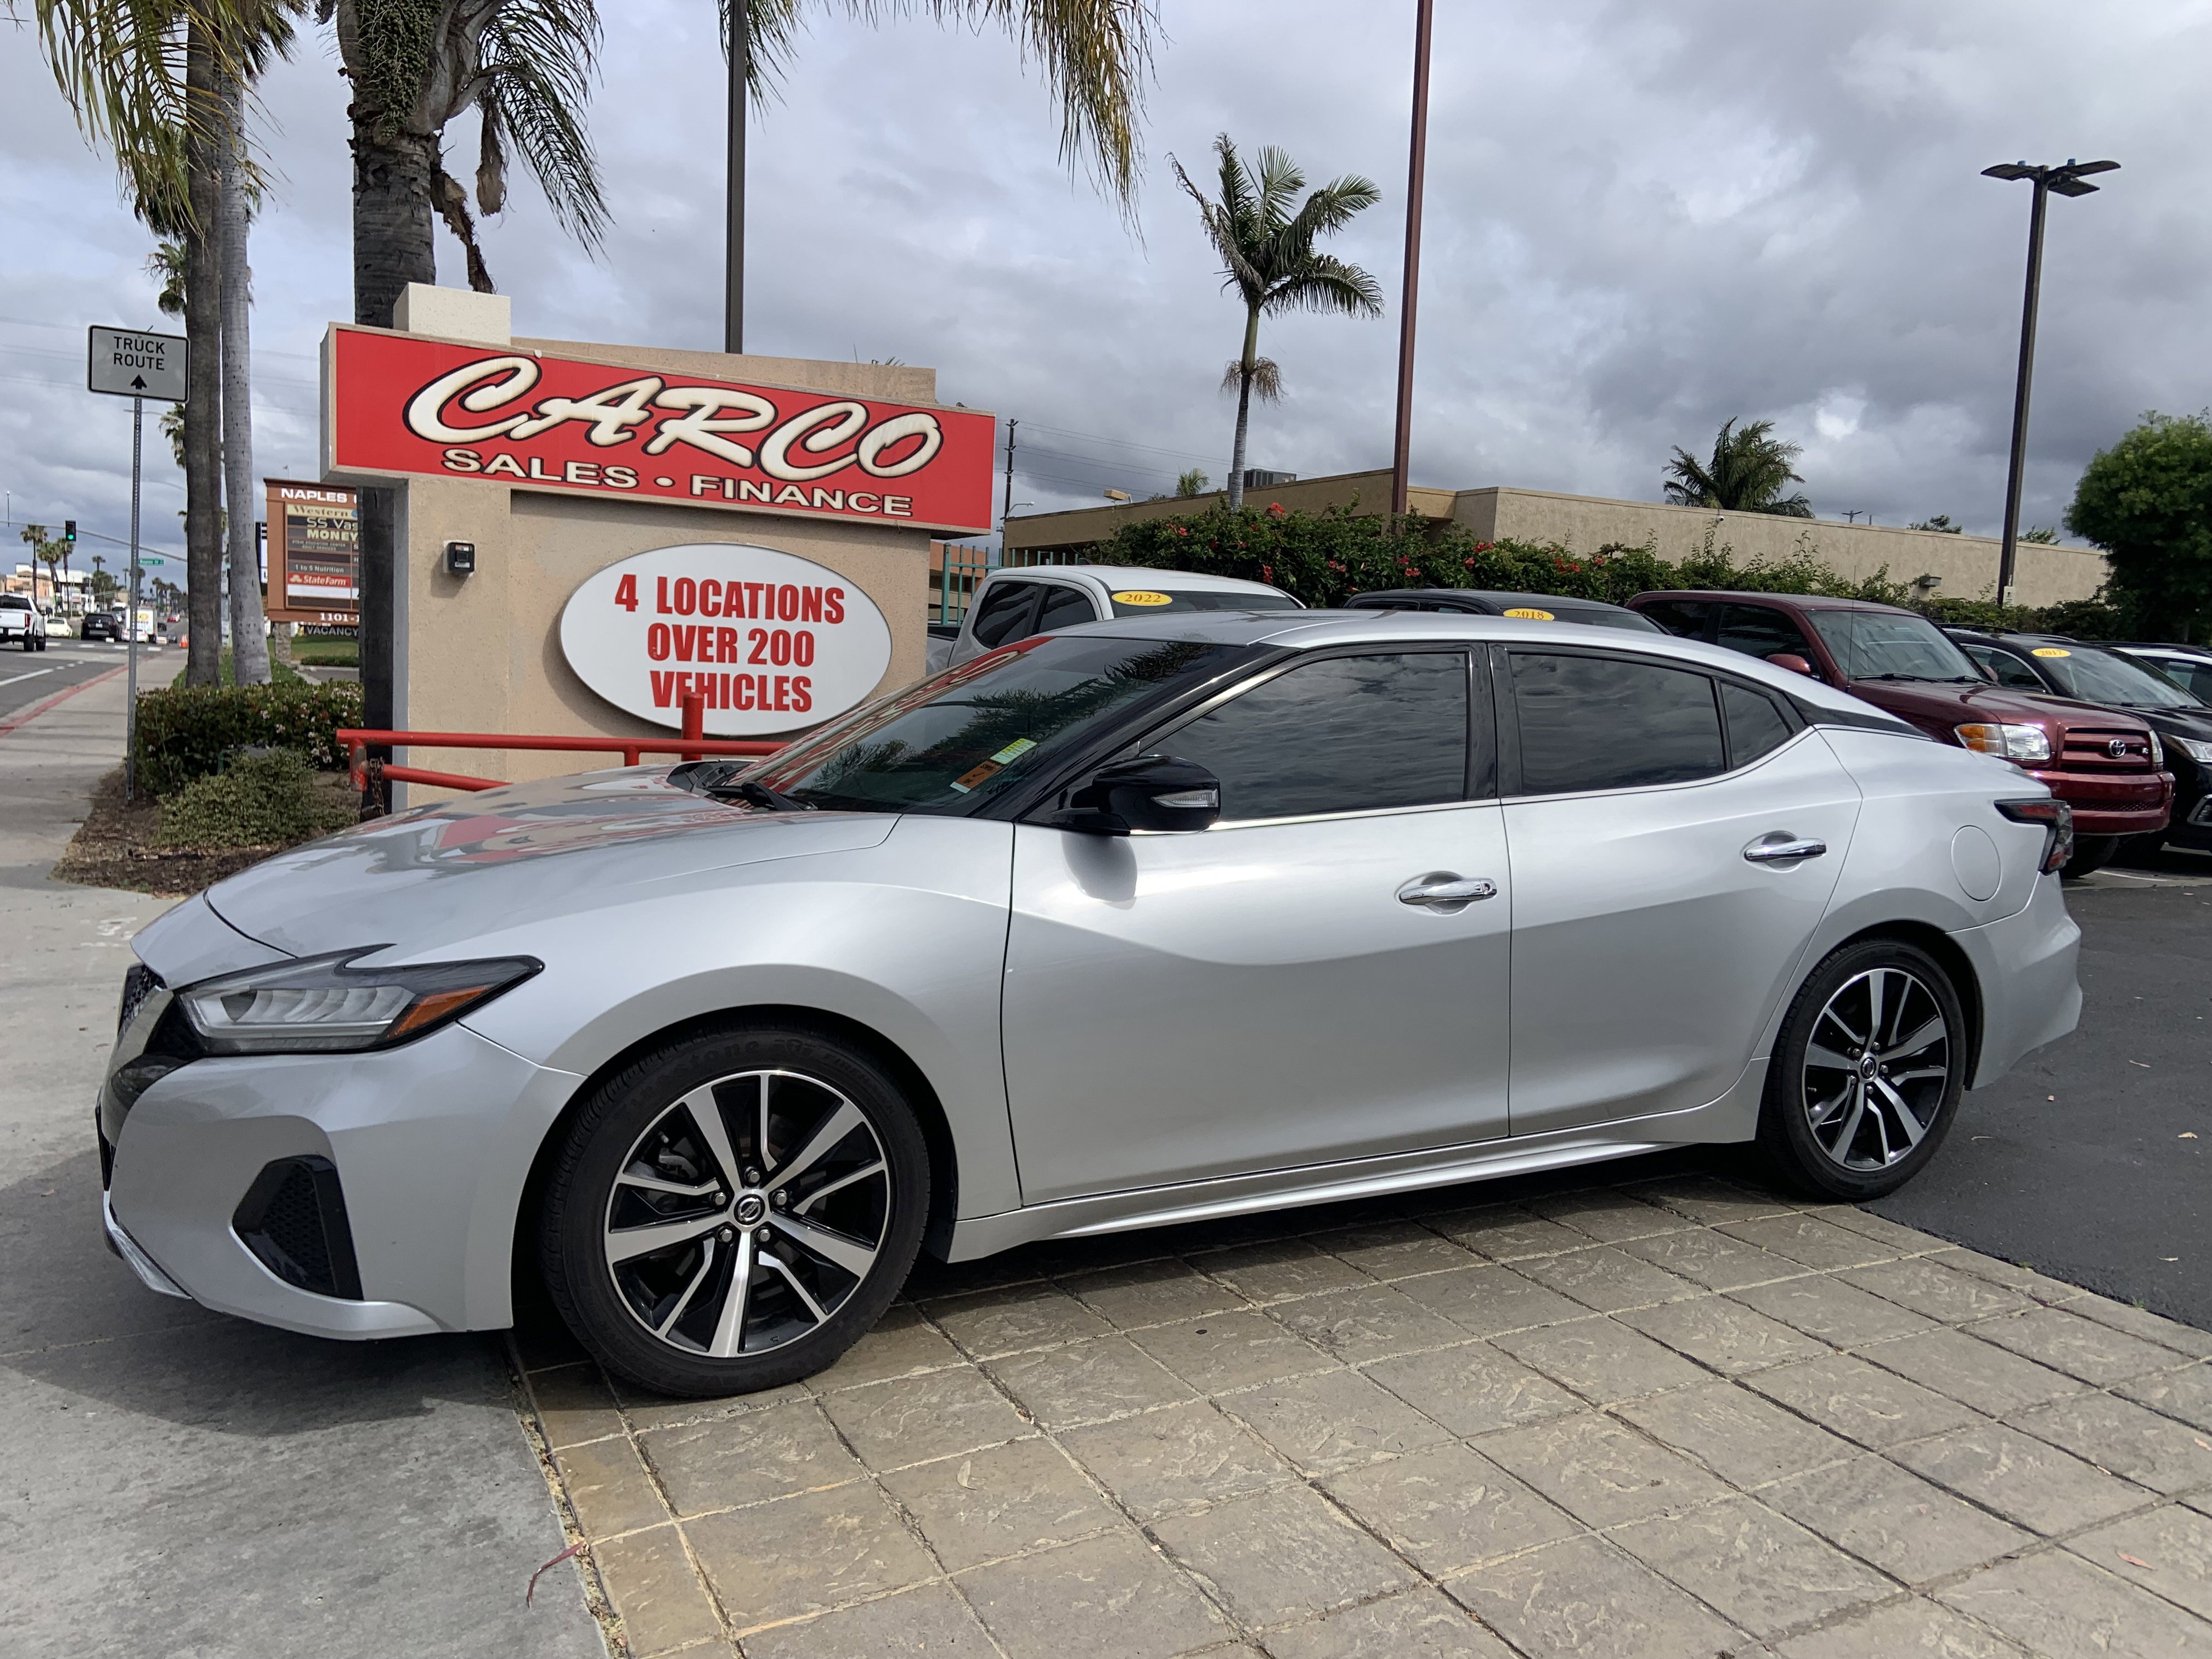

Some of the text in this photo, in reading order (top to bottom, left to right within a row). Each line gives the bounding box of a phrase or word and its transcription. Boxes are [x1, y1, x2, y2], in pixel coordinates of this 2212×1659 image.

[114, 336, 165, 354] TRUCK
[114, 352, 165, 371] ROUTE
[403, 356, 943, 481] CARCO
[442, 448, 913, 517] SALES FINANCE
[281, 488, 347, 503] NAPLES
[294, 505, 348, 517] Western
[307, 516, 328, 529] SS
[307, 529, 358, 541] MONEY
[314, 565, 345, 574] Nutrition
[615, 574, 845, 624] 4 LOCATIONS
[1125, 594, 1161, 602] 2022
[1514, 611, 1544, 620] 2018
[307, 625, 359, 636] VACANCY
[647, 622, 815, 668] OVER 200
[650, 670, 812, 713] VEHICLES
[741, 1200, 761, 1220] NISSAN
